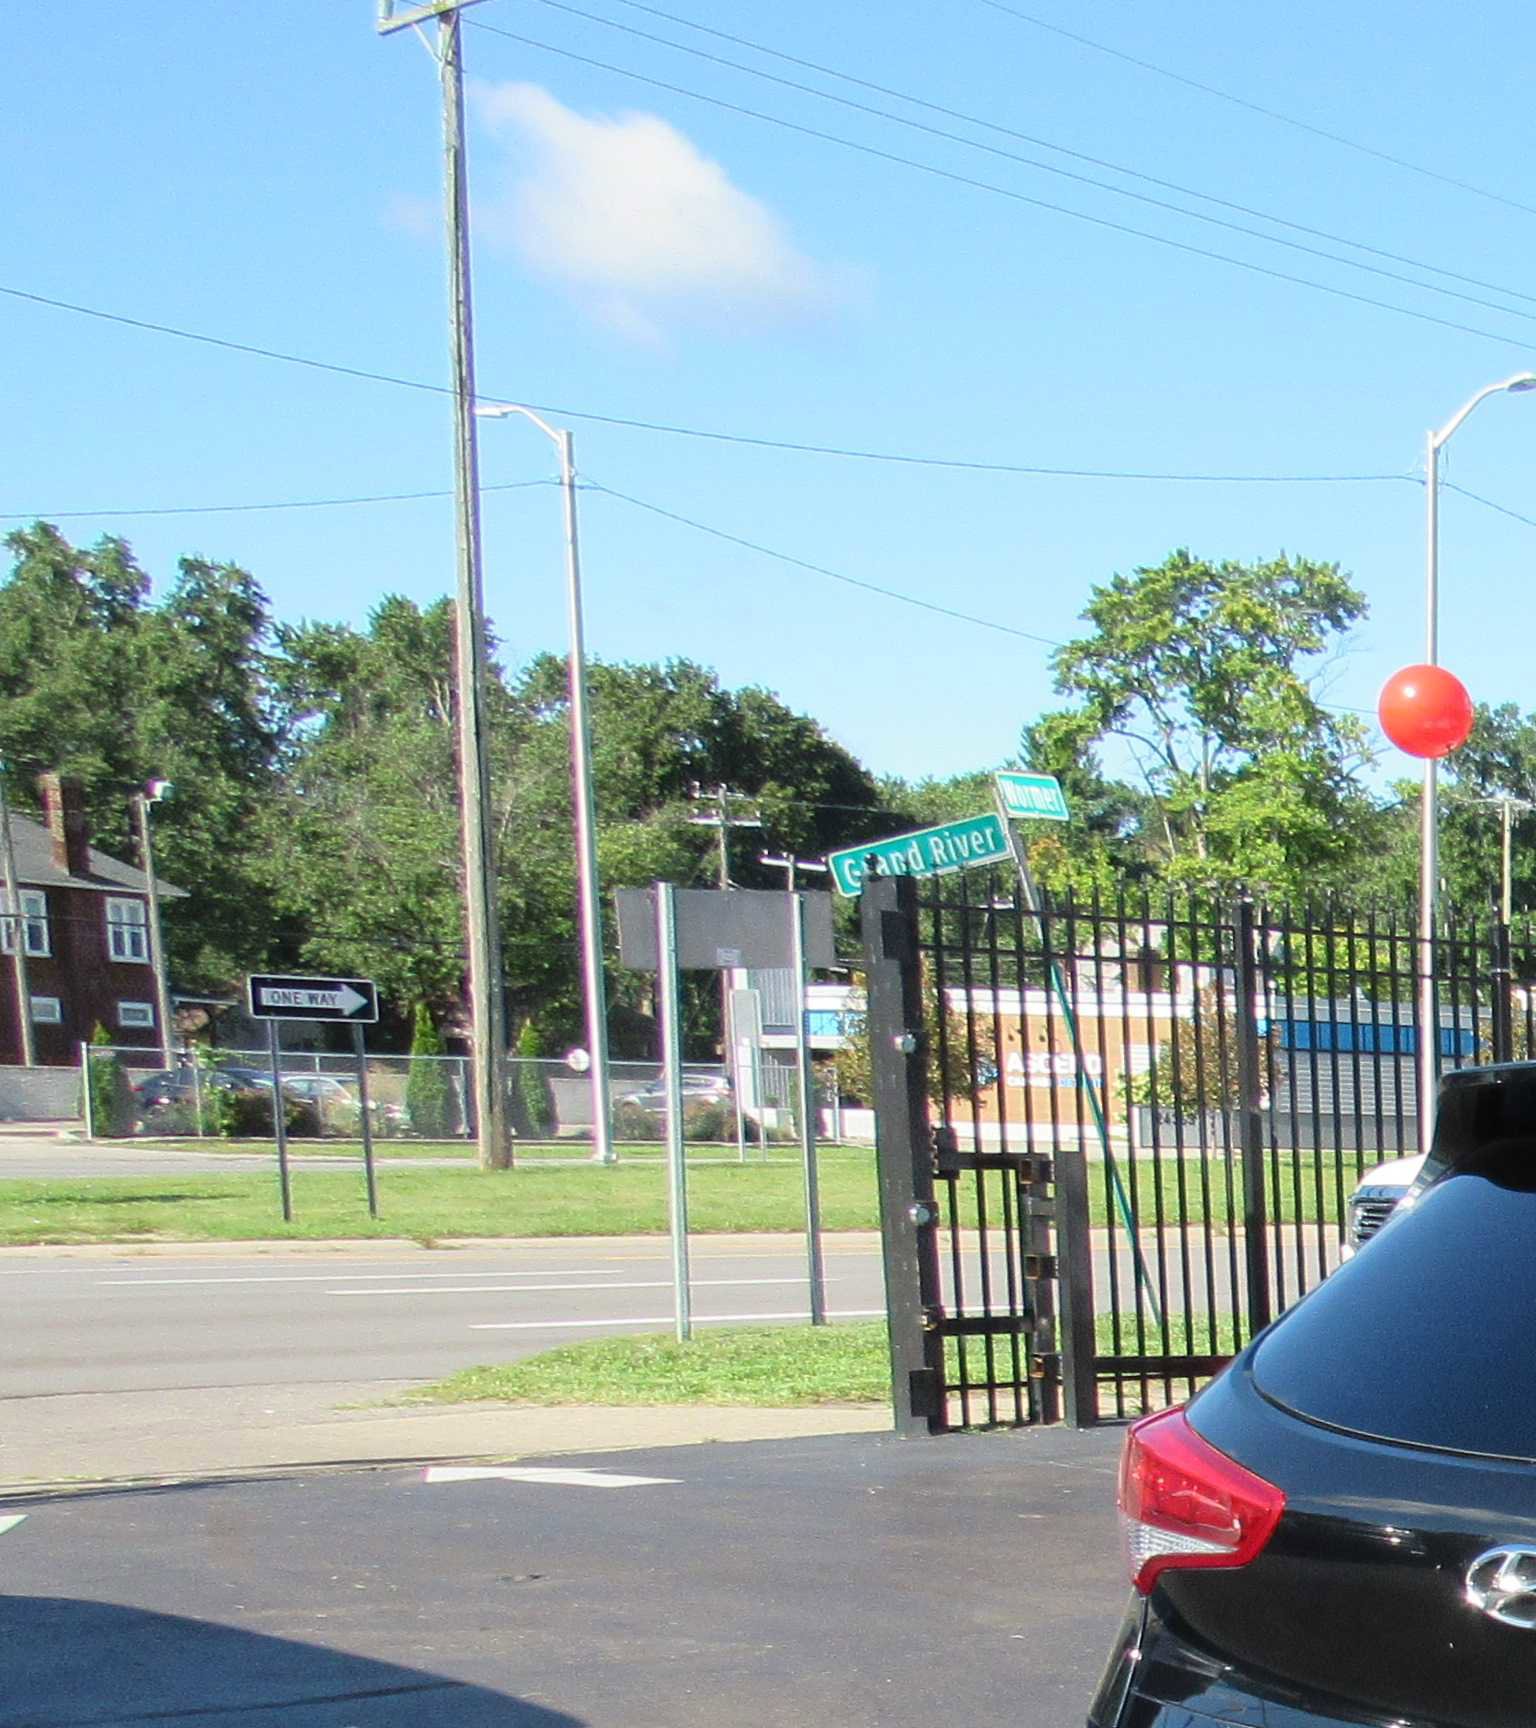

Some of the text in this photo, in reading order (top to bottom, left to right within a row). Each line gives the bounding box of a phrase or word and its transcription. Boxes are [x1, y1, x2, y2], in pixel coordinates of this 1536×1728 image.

[843, 826, 996, 888] Gand River
[270, 990, 338, 1006] ONE WAY
